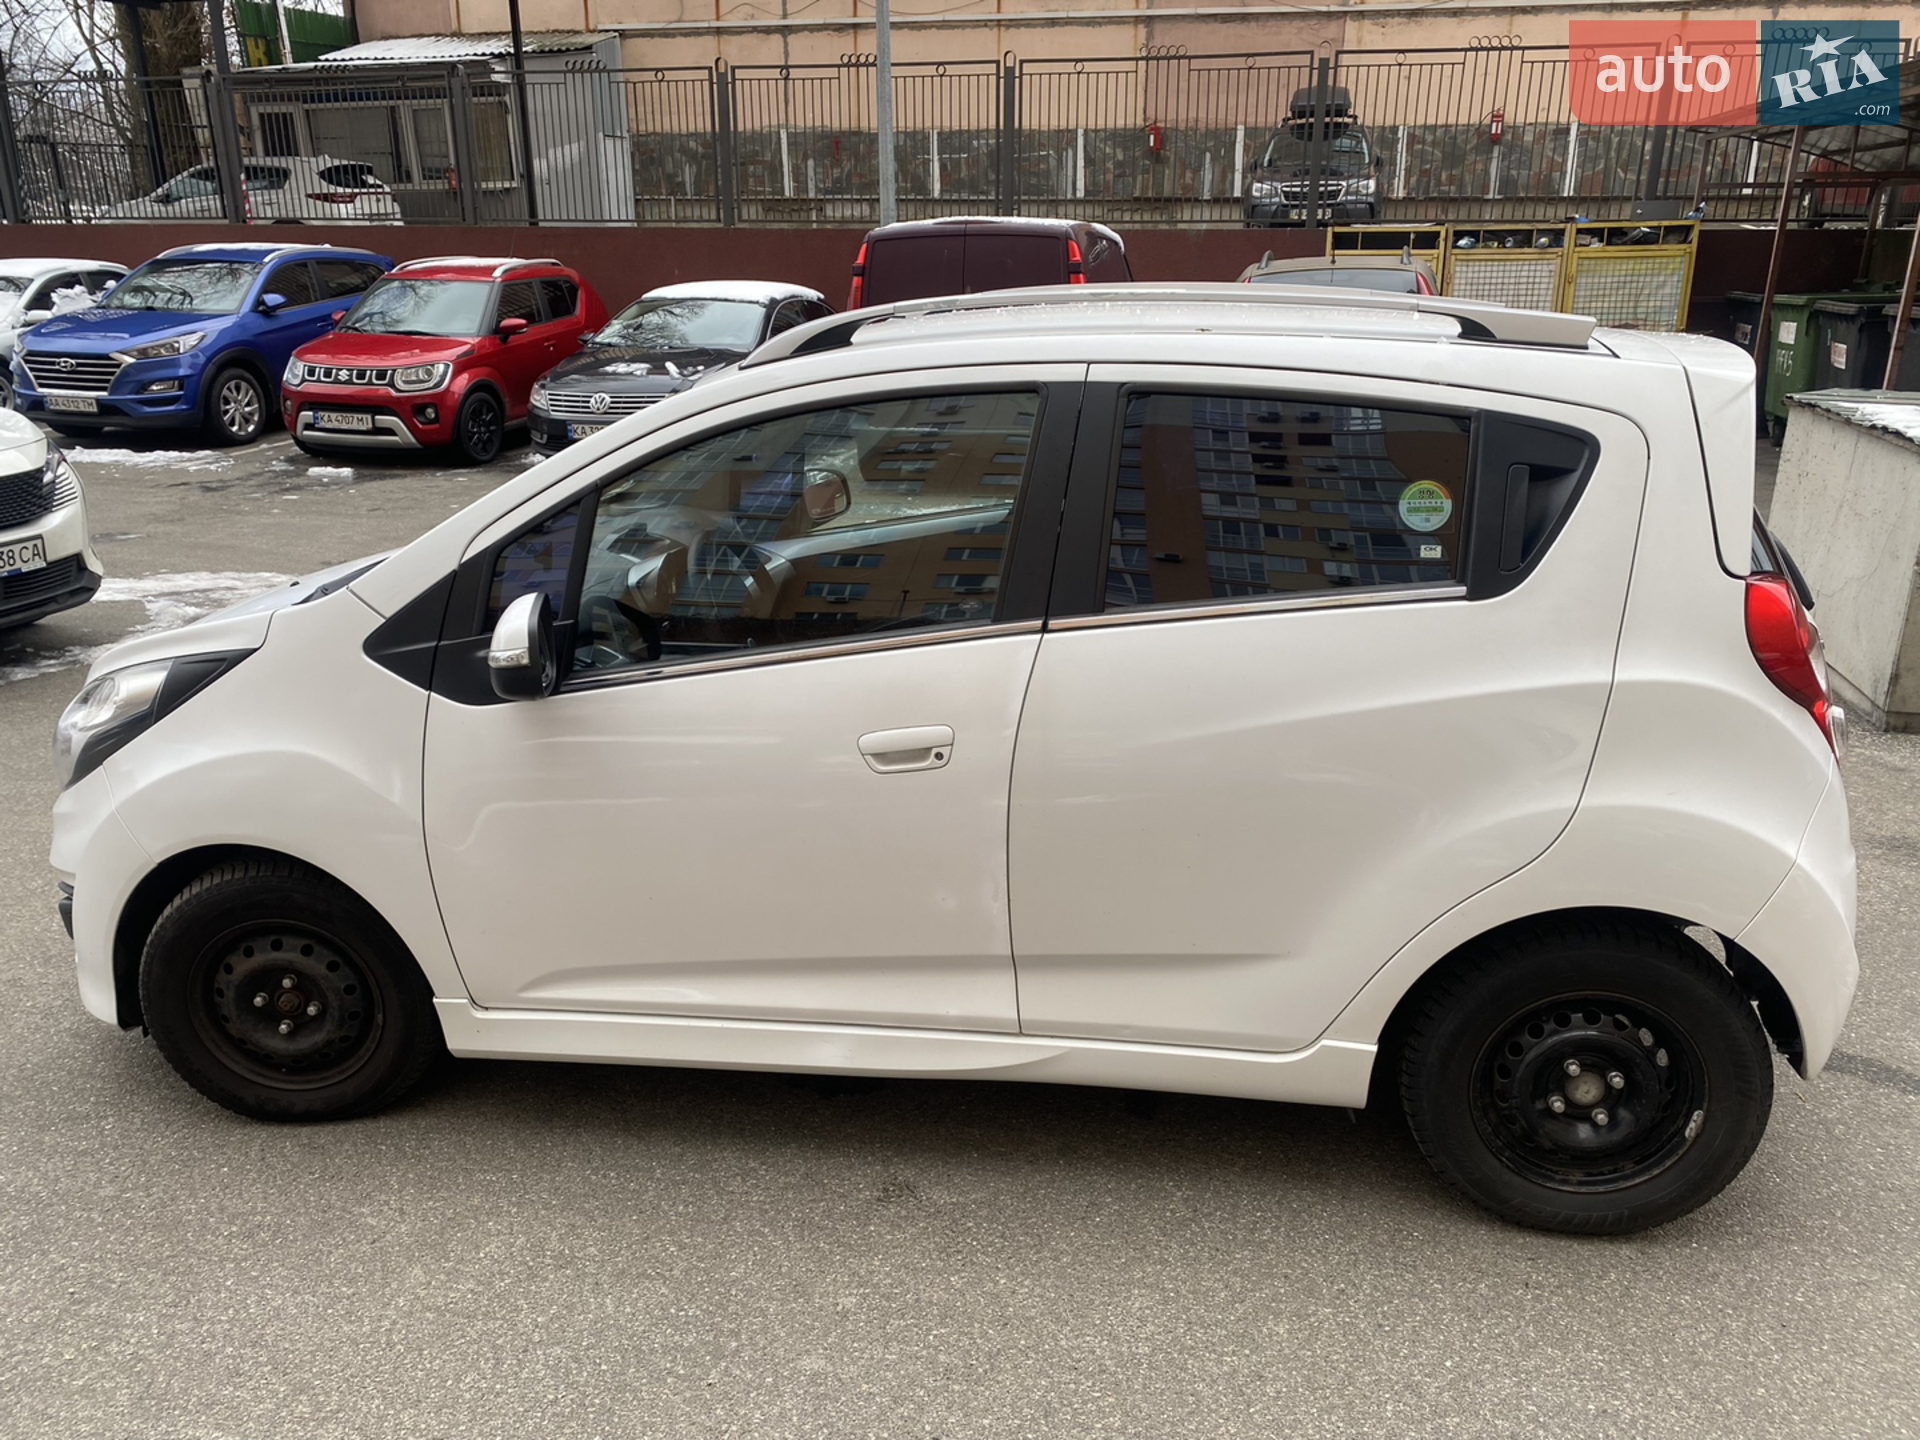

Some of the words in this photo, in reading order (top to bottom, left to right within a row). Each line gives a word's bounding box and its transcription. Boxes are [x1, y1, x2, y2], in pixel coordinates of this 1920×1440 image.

[48, 398, 60, 408] AA
[61, 399, 80, 409] 4312
[81, 399, 95, 410] TM
[319, 413, 333, 424] KA
[334, 414, 355, 425] 4707
[356, 415, 369, 426] MI
[573, 426, 587, 437] KA
[19, 543, 42, 564] CA
